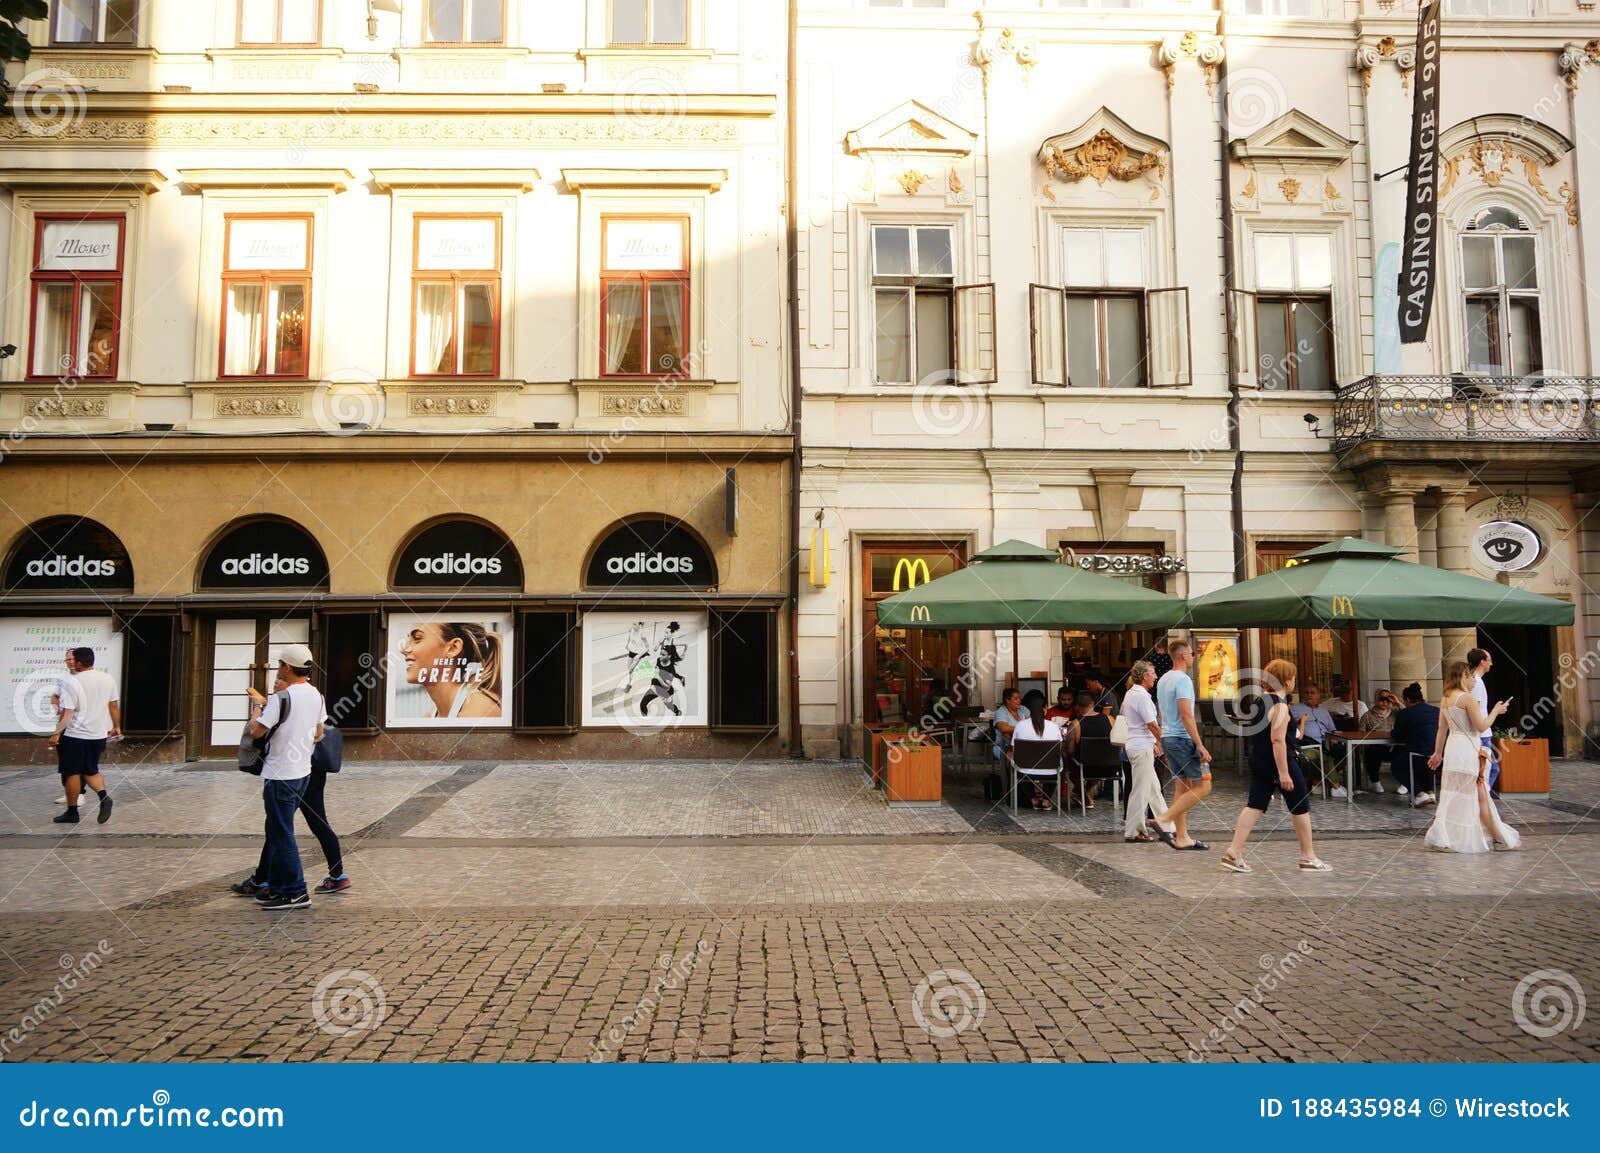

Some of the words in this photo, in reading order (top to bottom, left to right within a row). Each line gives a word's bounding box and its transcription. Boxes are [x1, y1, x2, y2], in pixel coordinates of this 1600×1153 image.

[1421, 18, 1437, 102] 1905
[1415, 109, 1435, 203] SINCE
[58, 239, 111, 258] Moser
[1404, 213, 1432, 328] CASINO
[26, 555, 116, 577] adidas
[221, 553, 310, 575] adidas
[414, 553, 502, 574] adidas
[606, 552, 694, 573] adidas
[433, 658, 454, 666] HERE
[457, 657, 468, 665] TO
[417, 667, 484, 683] CREATE
